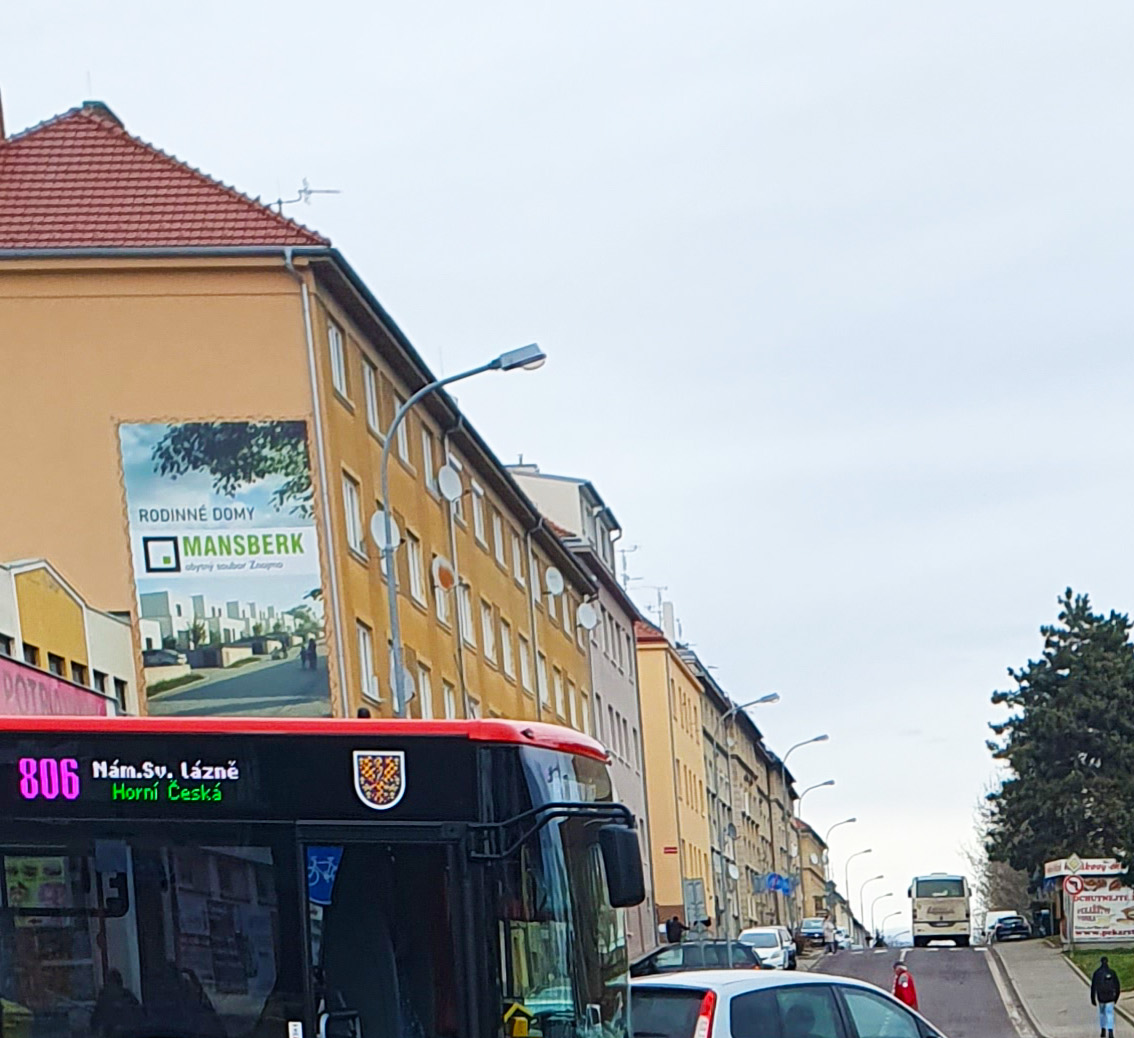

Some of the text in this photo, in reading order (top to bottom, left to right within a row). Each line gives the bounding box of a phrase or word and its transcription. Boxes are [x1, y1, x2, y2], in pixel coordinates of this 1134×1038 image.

[138, 504, 255, 523] RODINNÉ DOMY
[182, 532, 304, 557] MANSBERK
[18, 757, 80, 800] 806
[112, 779, 222, 801] Horní Česká
